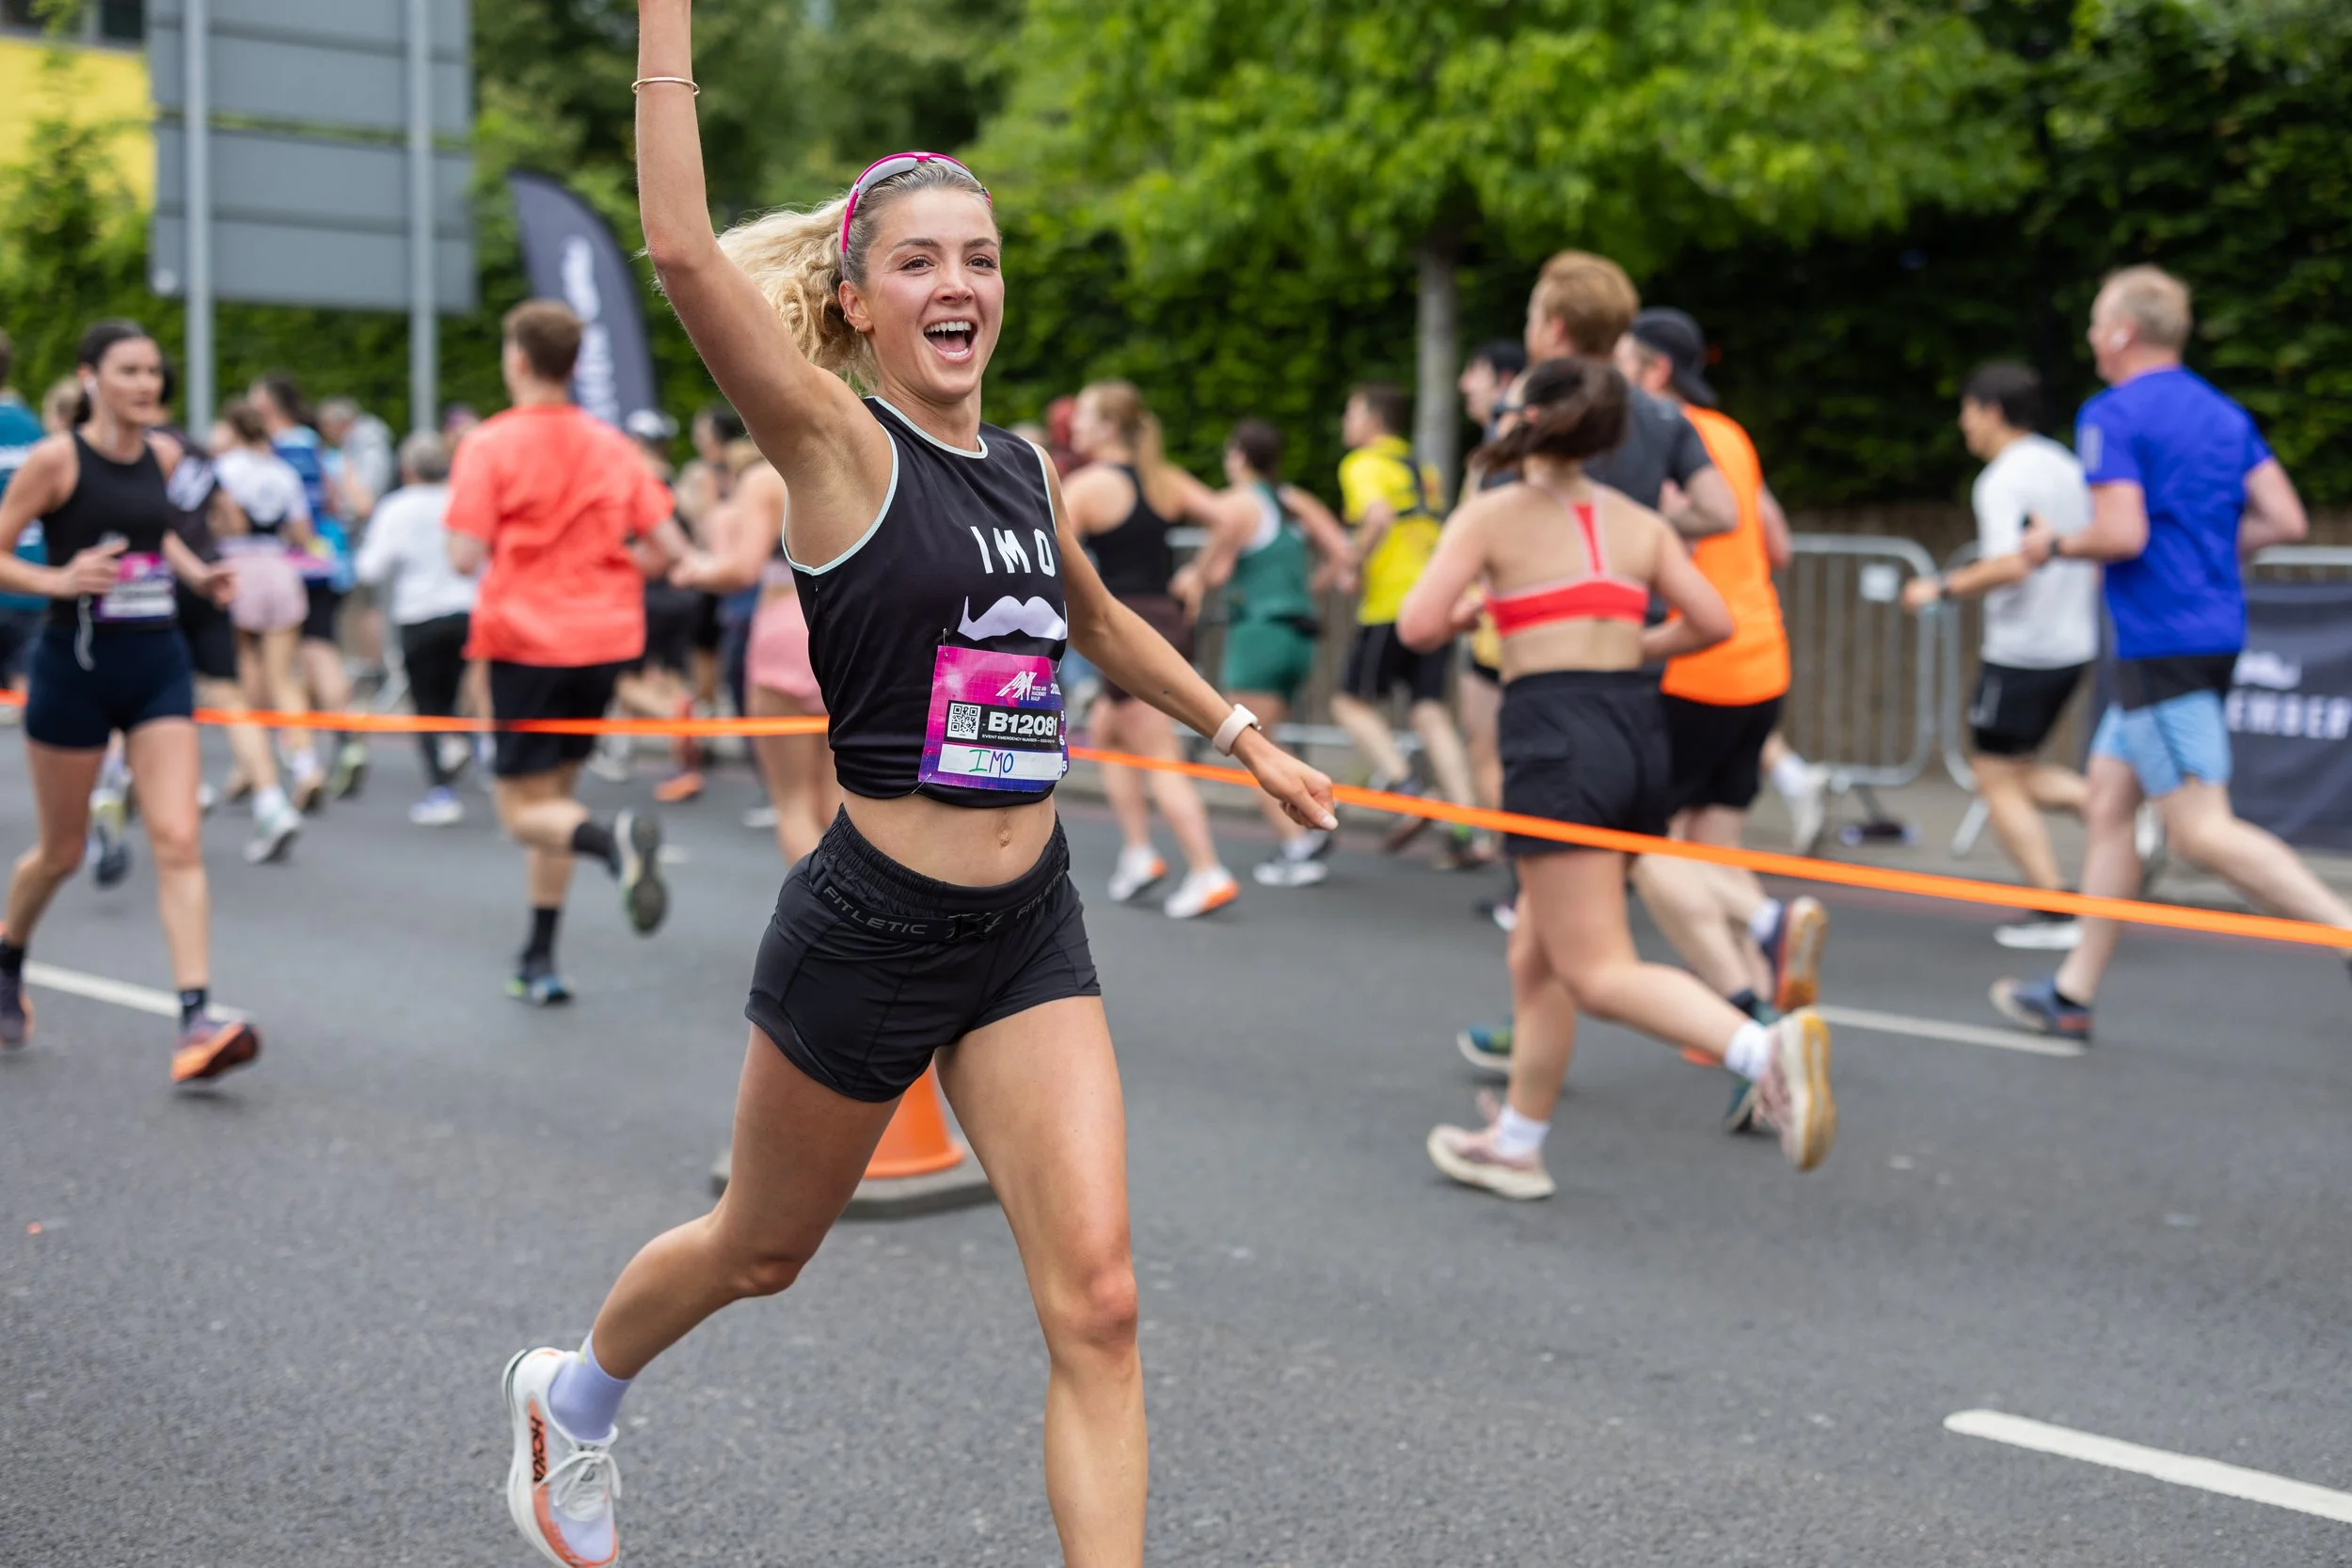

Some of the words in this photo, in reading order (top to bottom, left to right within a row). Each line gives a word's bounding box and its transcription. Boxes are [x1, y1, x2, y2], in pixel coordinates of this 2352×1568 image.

[970, 526, 1056, 577] IMO
[988, 711, 1057, 736] B12081
[968, 749, 1014, 779] IMO
[823, 885, 928, 935] FITLETIC
